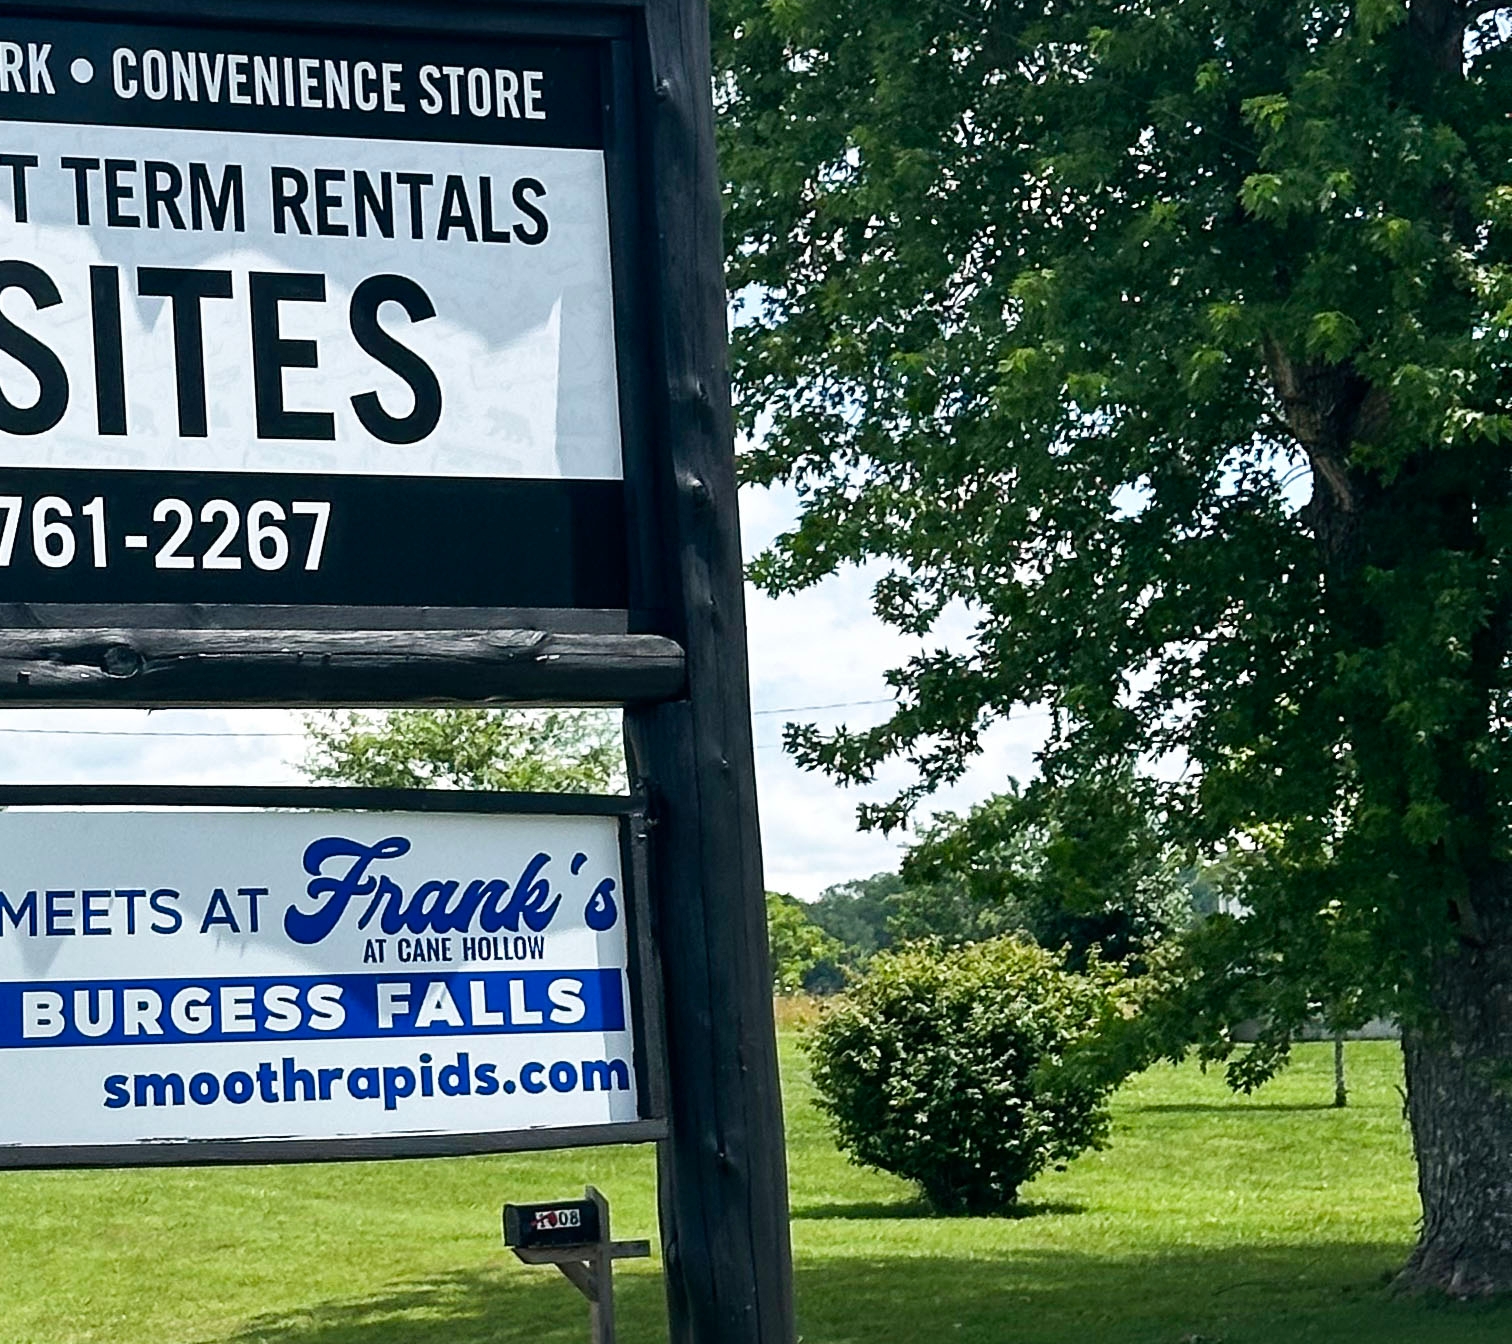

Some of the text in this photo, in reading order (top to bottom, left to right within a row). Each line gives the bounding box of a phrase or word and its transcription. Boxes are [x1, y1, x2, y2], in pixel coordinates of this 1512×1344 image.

[112, 47, 406, 113] CONVENIENCE
[419, 64, 546, 120] STORE
[60, 156, 245, 233] TERM
[270, 166, 549, 246] RENTALS
[199, 887, 269, 934] AT
[283, 836, 619, 936] Frank's
[363, 935, 545, 964] AT CANE HOLLOW
[22, 984, 346, 1038] BURGESS
[376, 978, 586, 1029] FALLS
[103, 1052, 631, 1111] smoothrapids.com
